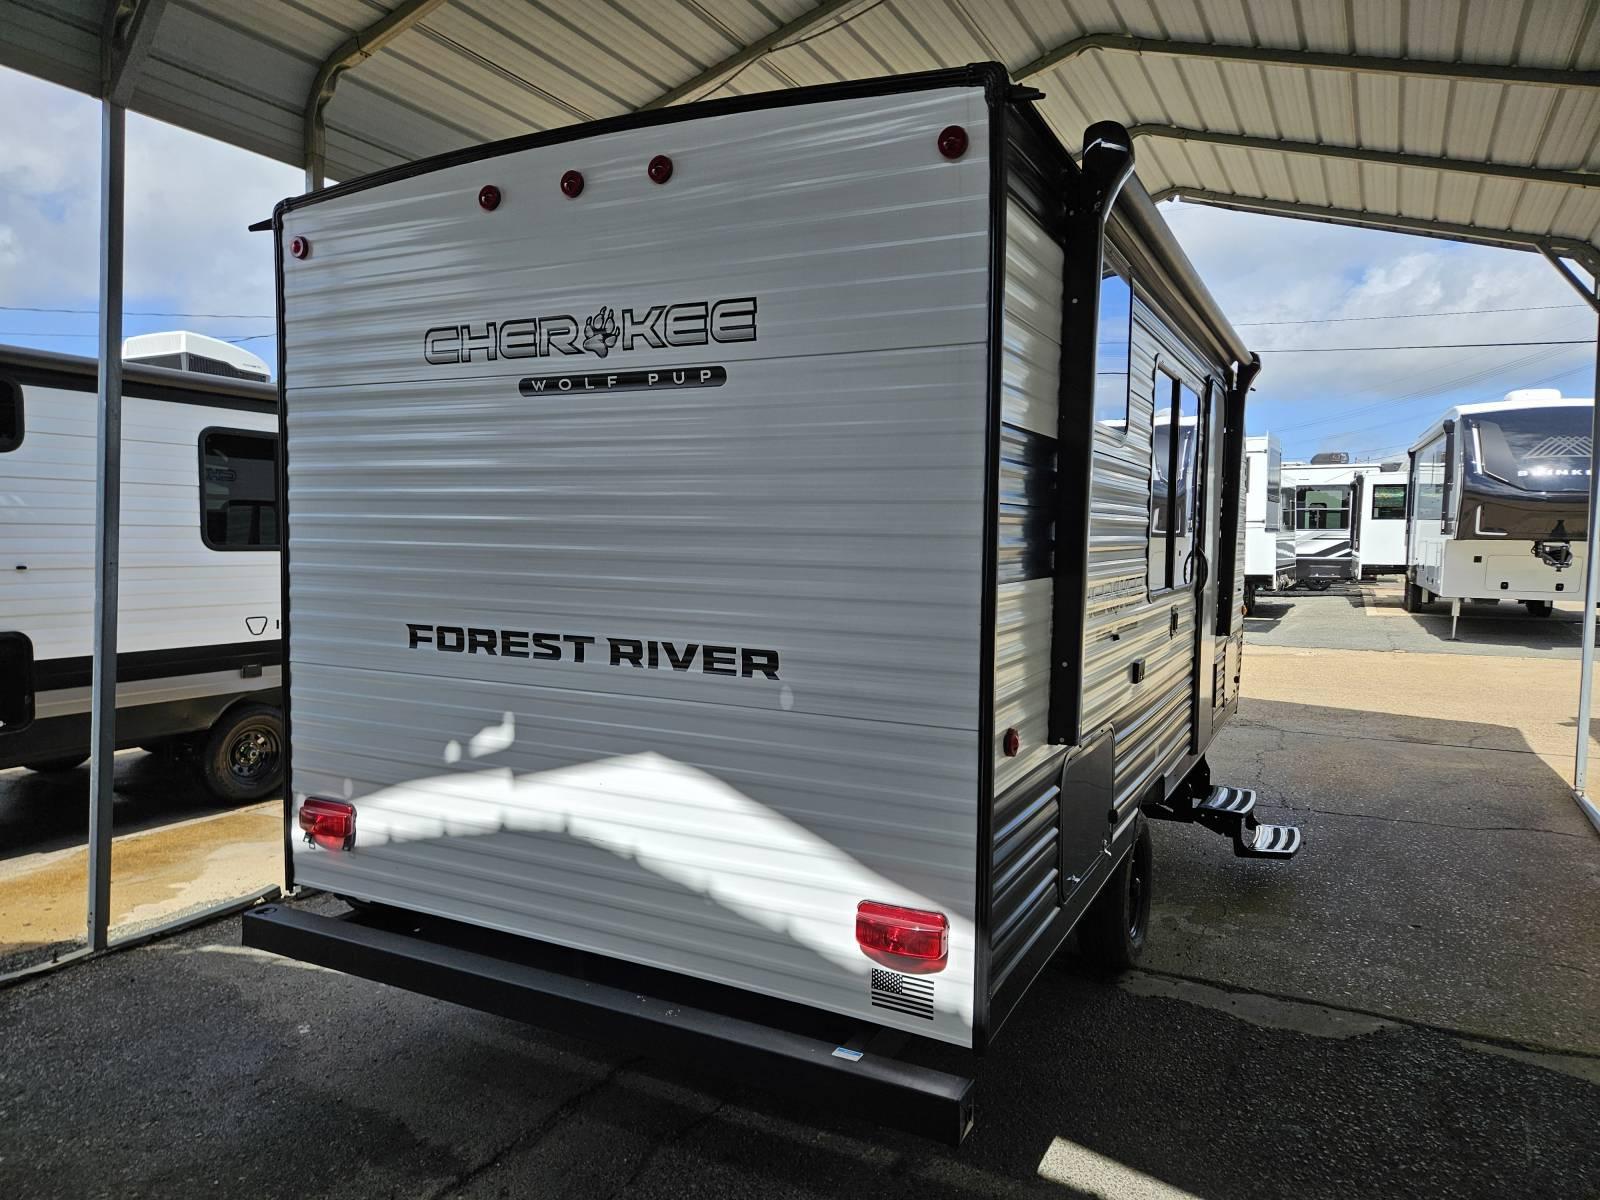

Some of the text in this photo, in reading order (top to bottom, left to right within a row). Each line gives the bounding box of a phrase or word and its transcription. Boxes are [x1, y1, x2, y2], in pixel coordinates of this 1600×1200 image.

[531, 370, 712, 392] WOLF PUP
[406, 624, 780, 680] FOREST RIVER
